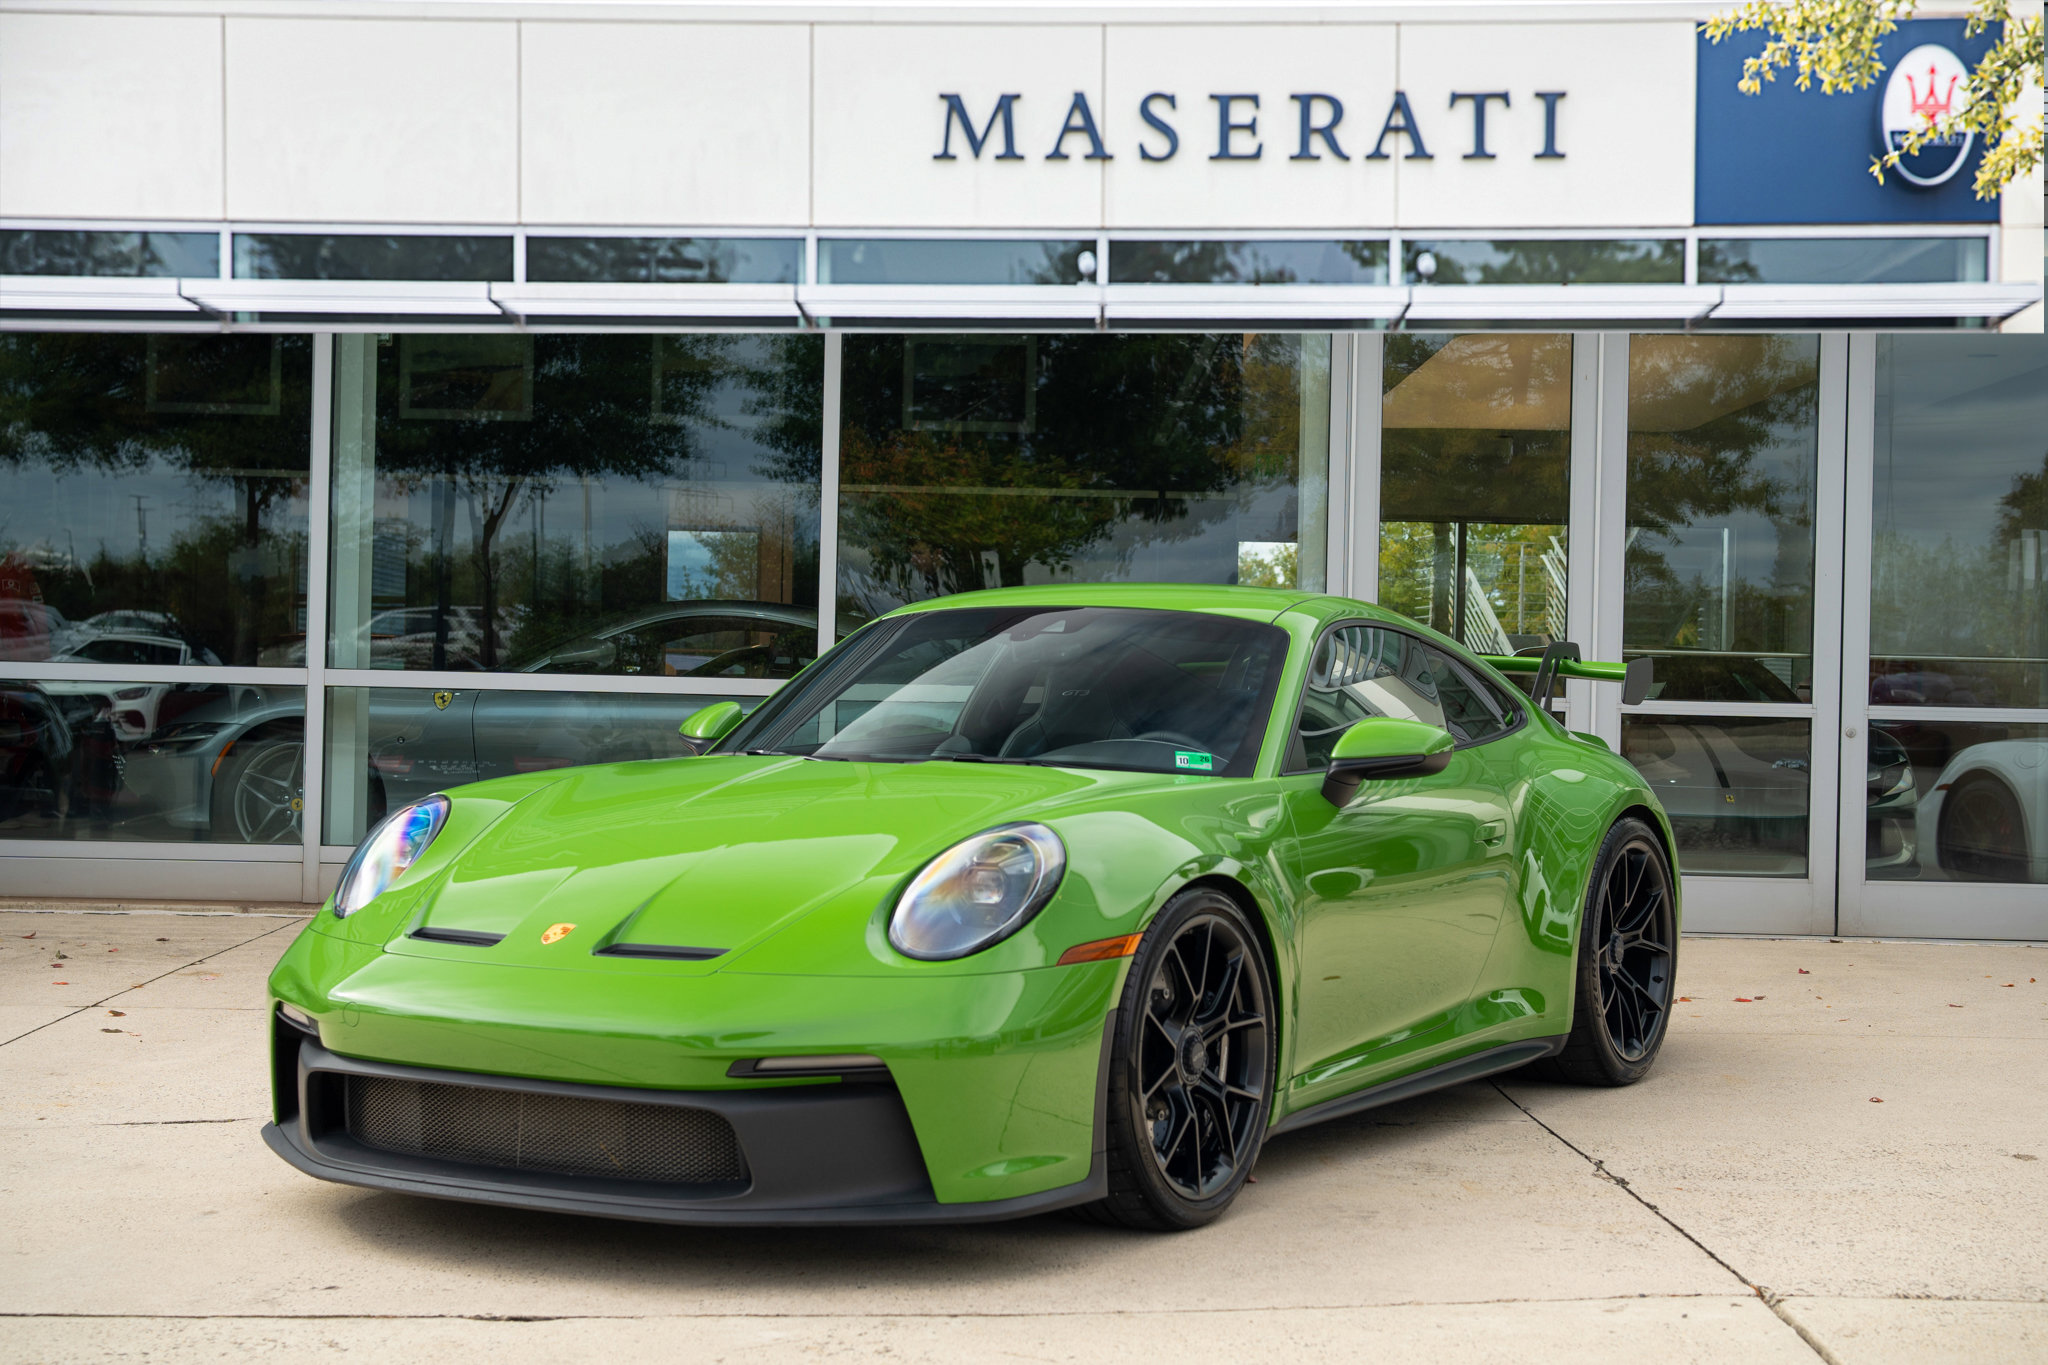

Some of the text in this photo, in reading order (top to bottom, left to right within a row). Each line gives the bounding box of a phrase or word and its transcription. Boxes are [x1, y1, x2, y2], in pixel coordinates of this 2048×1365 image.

[932, 91, 1567, 162] MASERATI
[1061, 689, 1090, 697] GT3
[1178, 757, 1189, 765] 10
